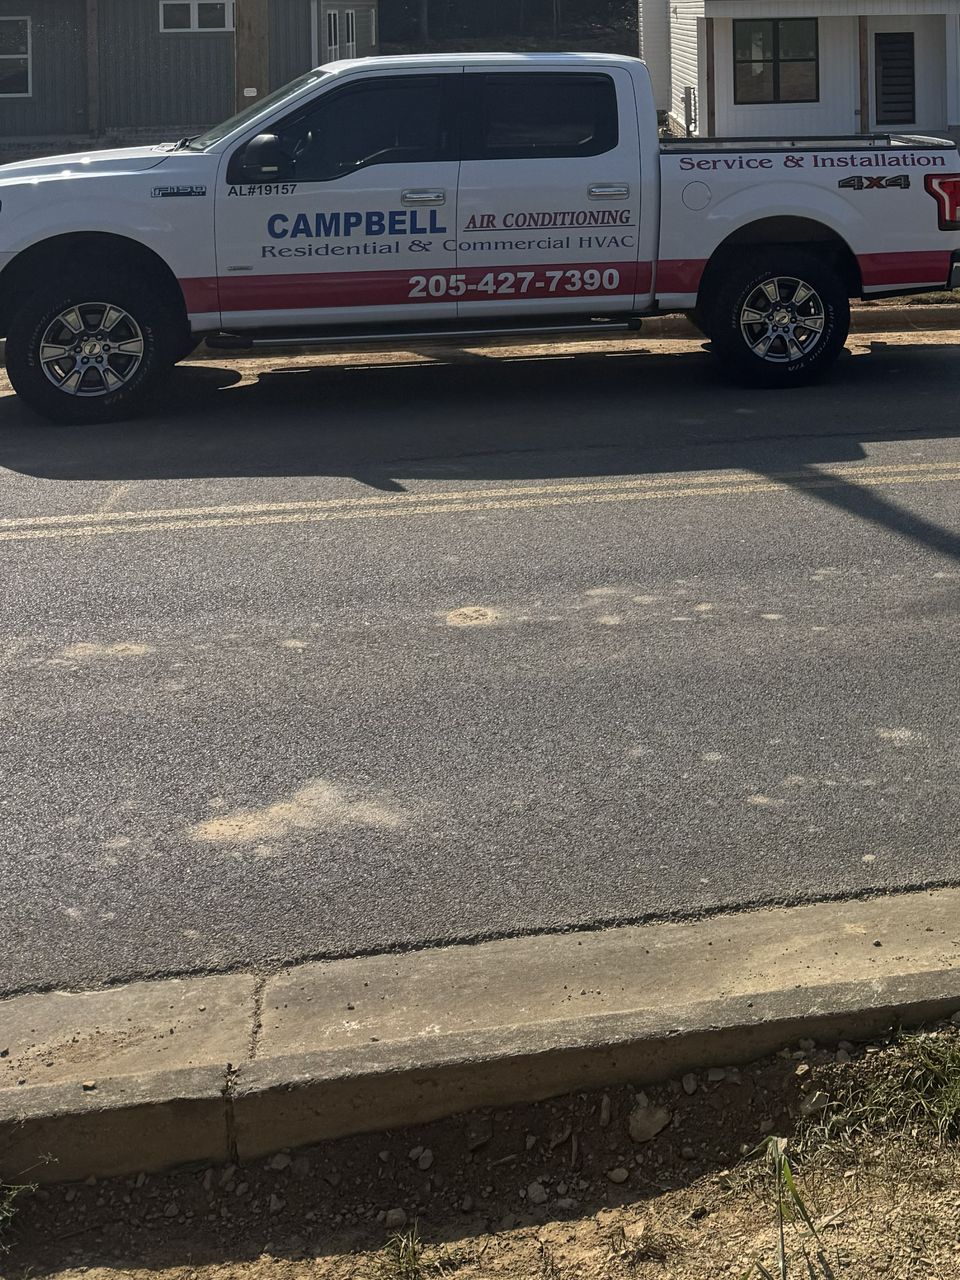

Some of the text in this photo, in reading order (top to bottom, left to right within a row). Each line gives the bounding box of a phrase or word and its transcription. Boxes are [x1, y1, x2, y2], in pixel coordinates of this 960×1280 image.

[680, 153, 946, 171] Service & Installation
[228, 184, 297, 196] AL#19157
[267, 209, 447, 239] CAMPBELL
[465, 210, 631, 229] AIR CONDITIONING
[261, 235, 634, 258] Residential & Commercial HVAC
[408, 269, 619, 297] 205-427-7390
